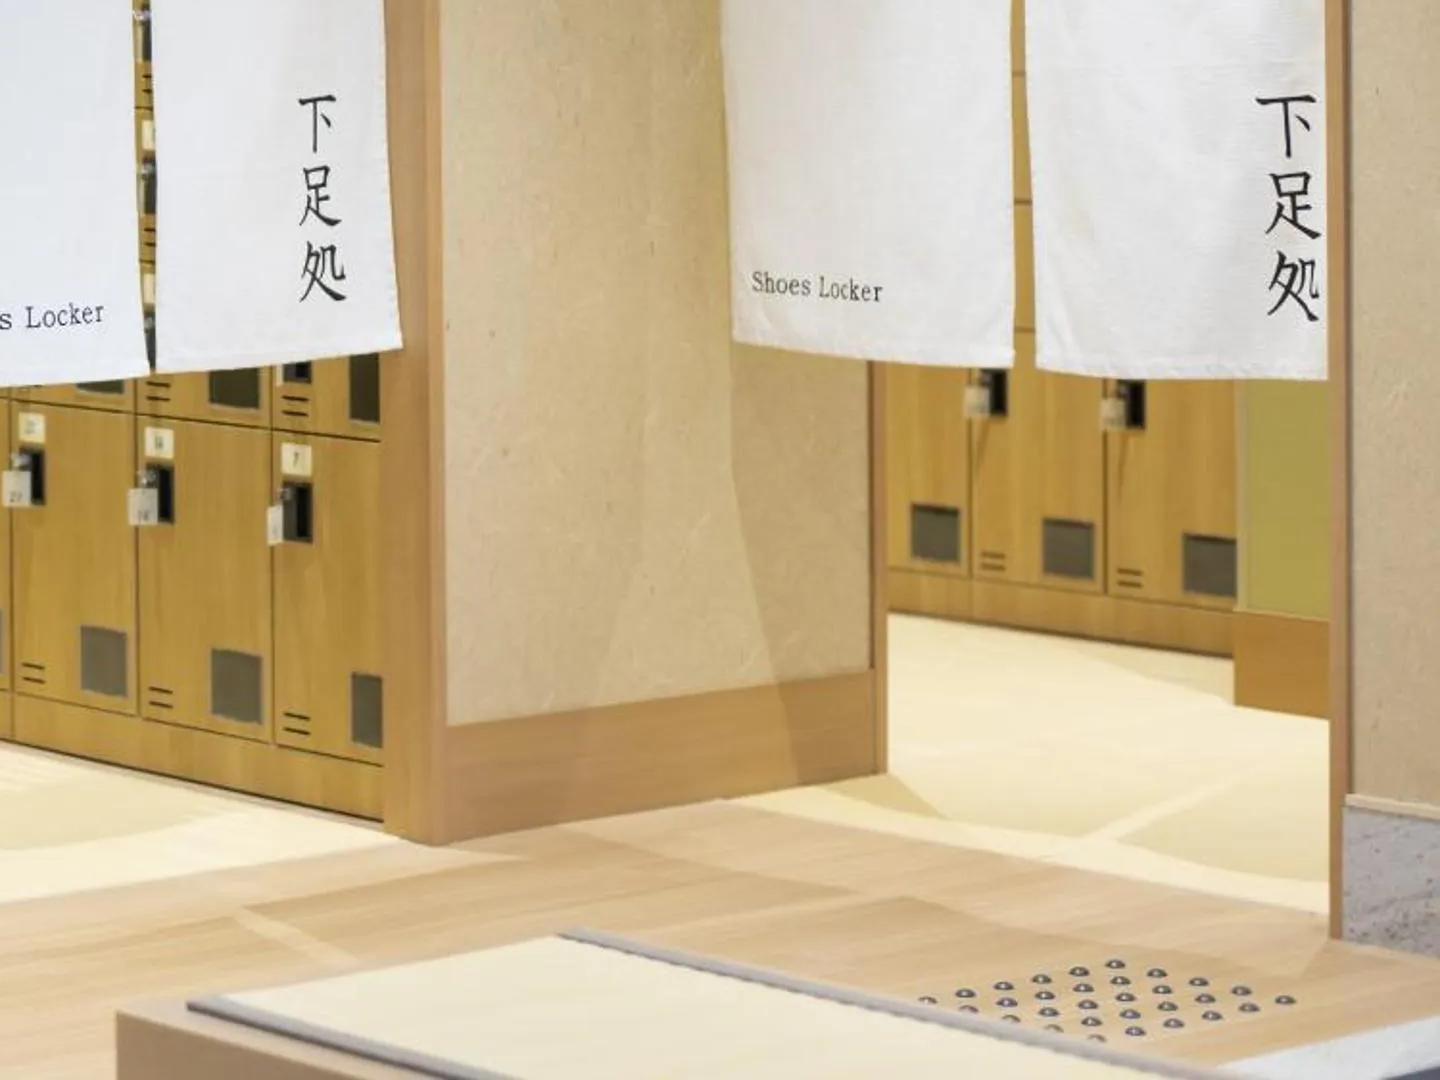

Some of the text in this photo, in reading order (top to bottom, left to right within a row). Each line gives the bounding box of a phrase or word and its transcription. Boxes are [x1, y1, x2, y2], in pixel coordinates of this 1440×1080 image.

[298, 94, 347, 303] 下足処
[1255, 94, 1322, 323] 下足処
[25, 302, 105, 329] Locker
[751, 270, 884, 303] Shoes Locker
